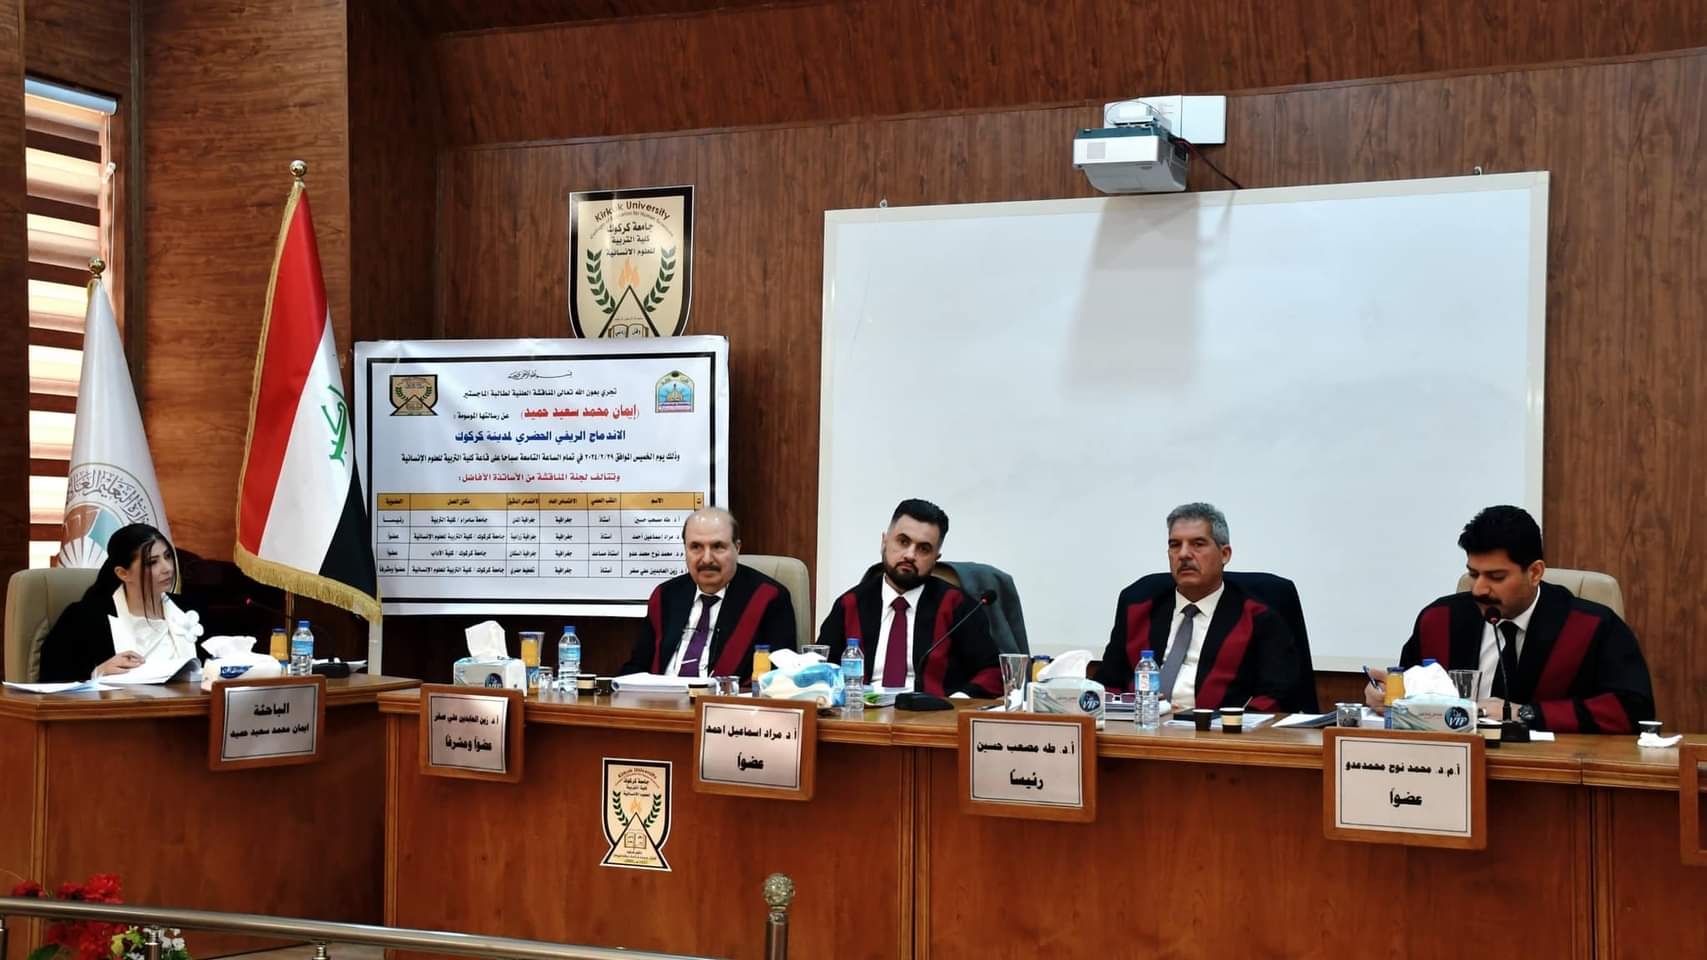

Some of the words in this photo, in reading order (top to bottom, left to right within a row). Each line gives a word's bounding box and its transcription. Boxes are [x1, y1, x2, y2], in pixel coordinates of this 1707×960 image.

[595, 204, 623, 222] Kirkk
[626, 200, 670, 221] University
[608, 222, 630, 234] كركوك
[632, 221, 653, 231] جامعة
[611, 235, 634, 245] التربية
[512, 388, 531, 397] العلنية
[532, 388, 555, 396] المناقشة
[552, 407, 579, 420] سعيد
[583, 405, 608, 417] محمد
[455, 431, 484, 444] كركوك
[487, 431, 512, 443] لمدينة
[516, 430, 552, 446] الحضري
[555, 431, 585, 443] الريفي
[589, 430, 626, 443] الاندماج
[444, 453, 461, 463] التربية
[463, 453, 474, 463] كلية
[542, 453, 561, 461] الساعة
[577, 453, 583, 464] في
[633, 452, 654, 462] الخميس
[537, 472, 567, 481] المناقشة
[570, 472, 587, 483] لجنة
[254, 702, 290, 717] الباحثة
[1082, 700, 1100, 710] VIP
[1449, 717, 1468, 726] VIP
[251, 728, 269, 737] سعيد
[272, 726, 290, 734] محمد
[706, 724, 725, 734] احمد
[728, 726, 762, 738] اسماعيل
[764, 728, 782, 740] مراد
[230, 730, 248, 739] حميد
[977, 741, 1003, 753] حسين
[1007, 744, 1039, 753] مصعب
[1043, 743, 1056, 753] طه
[1389, 762, 1404, 774] نوح
[1408, 764, 1431, 773] محمد
